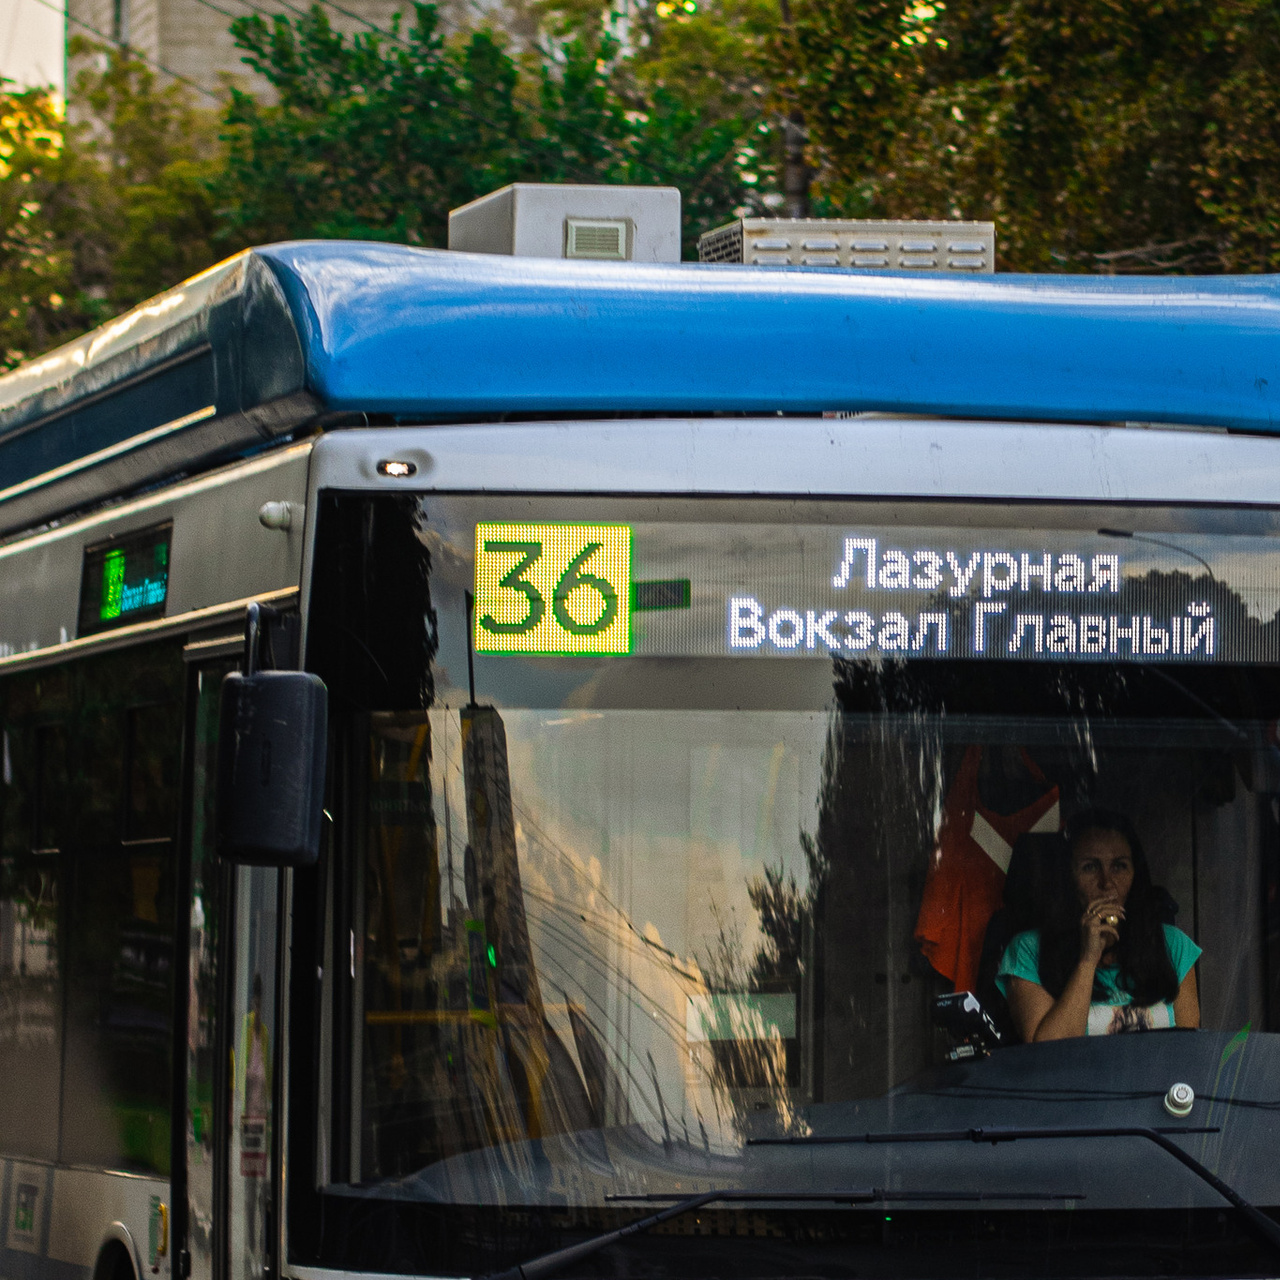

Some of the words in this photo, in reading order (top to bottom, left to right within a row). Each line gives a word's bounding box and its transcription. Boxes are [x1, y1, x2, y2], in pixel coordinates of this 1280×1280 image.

[480, 541, 618, 635] 36
[833, 538, 1120, 597] Лазурная
[730, 597, 947, 650] Вокзал
[974, 601, 1216, 655] Главный
